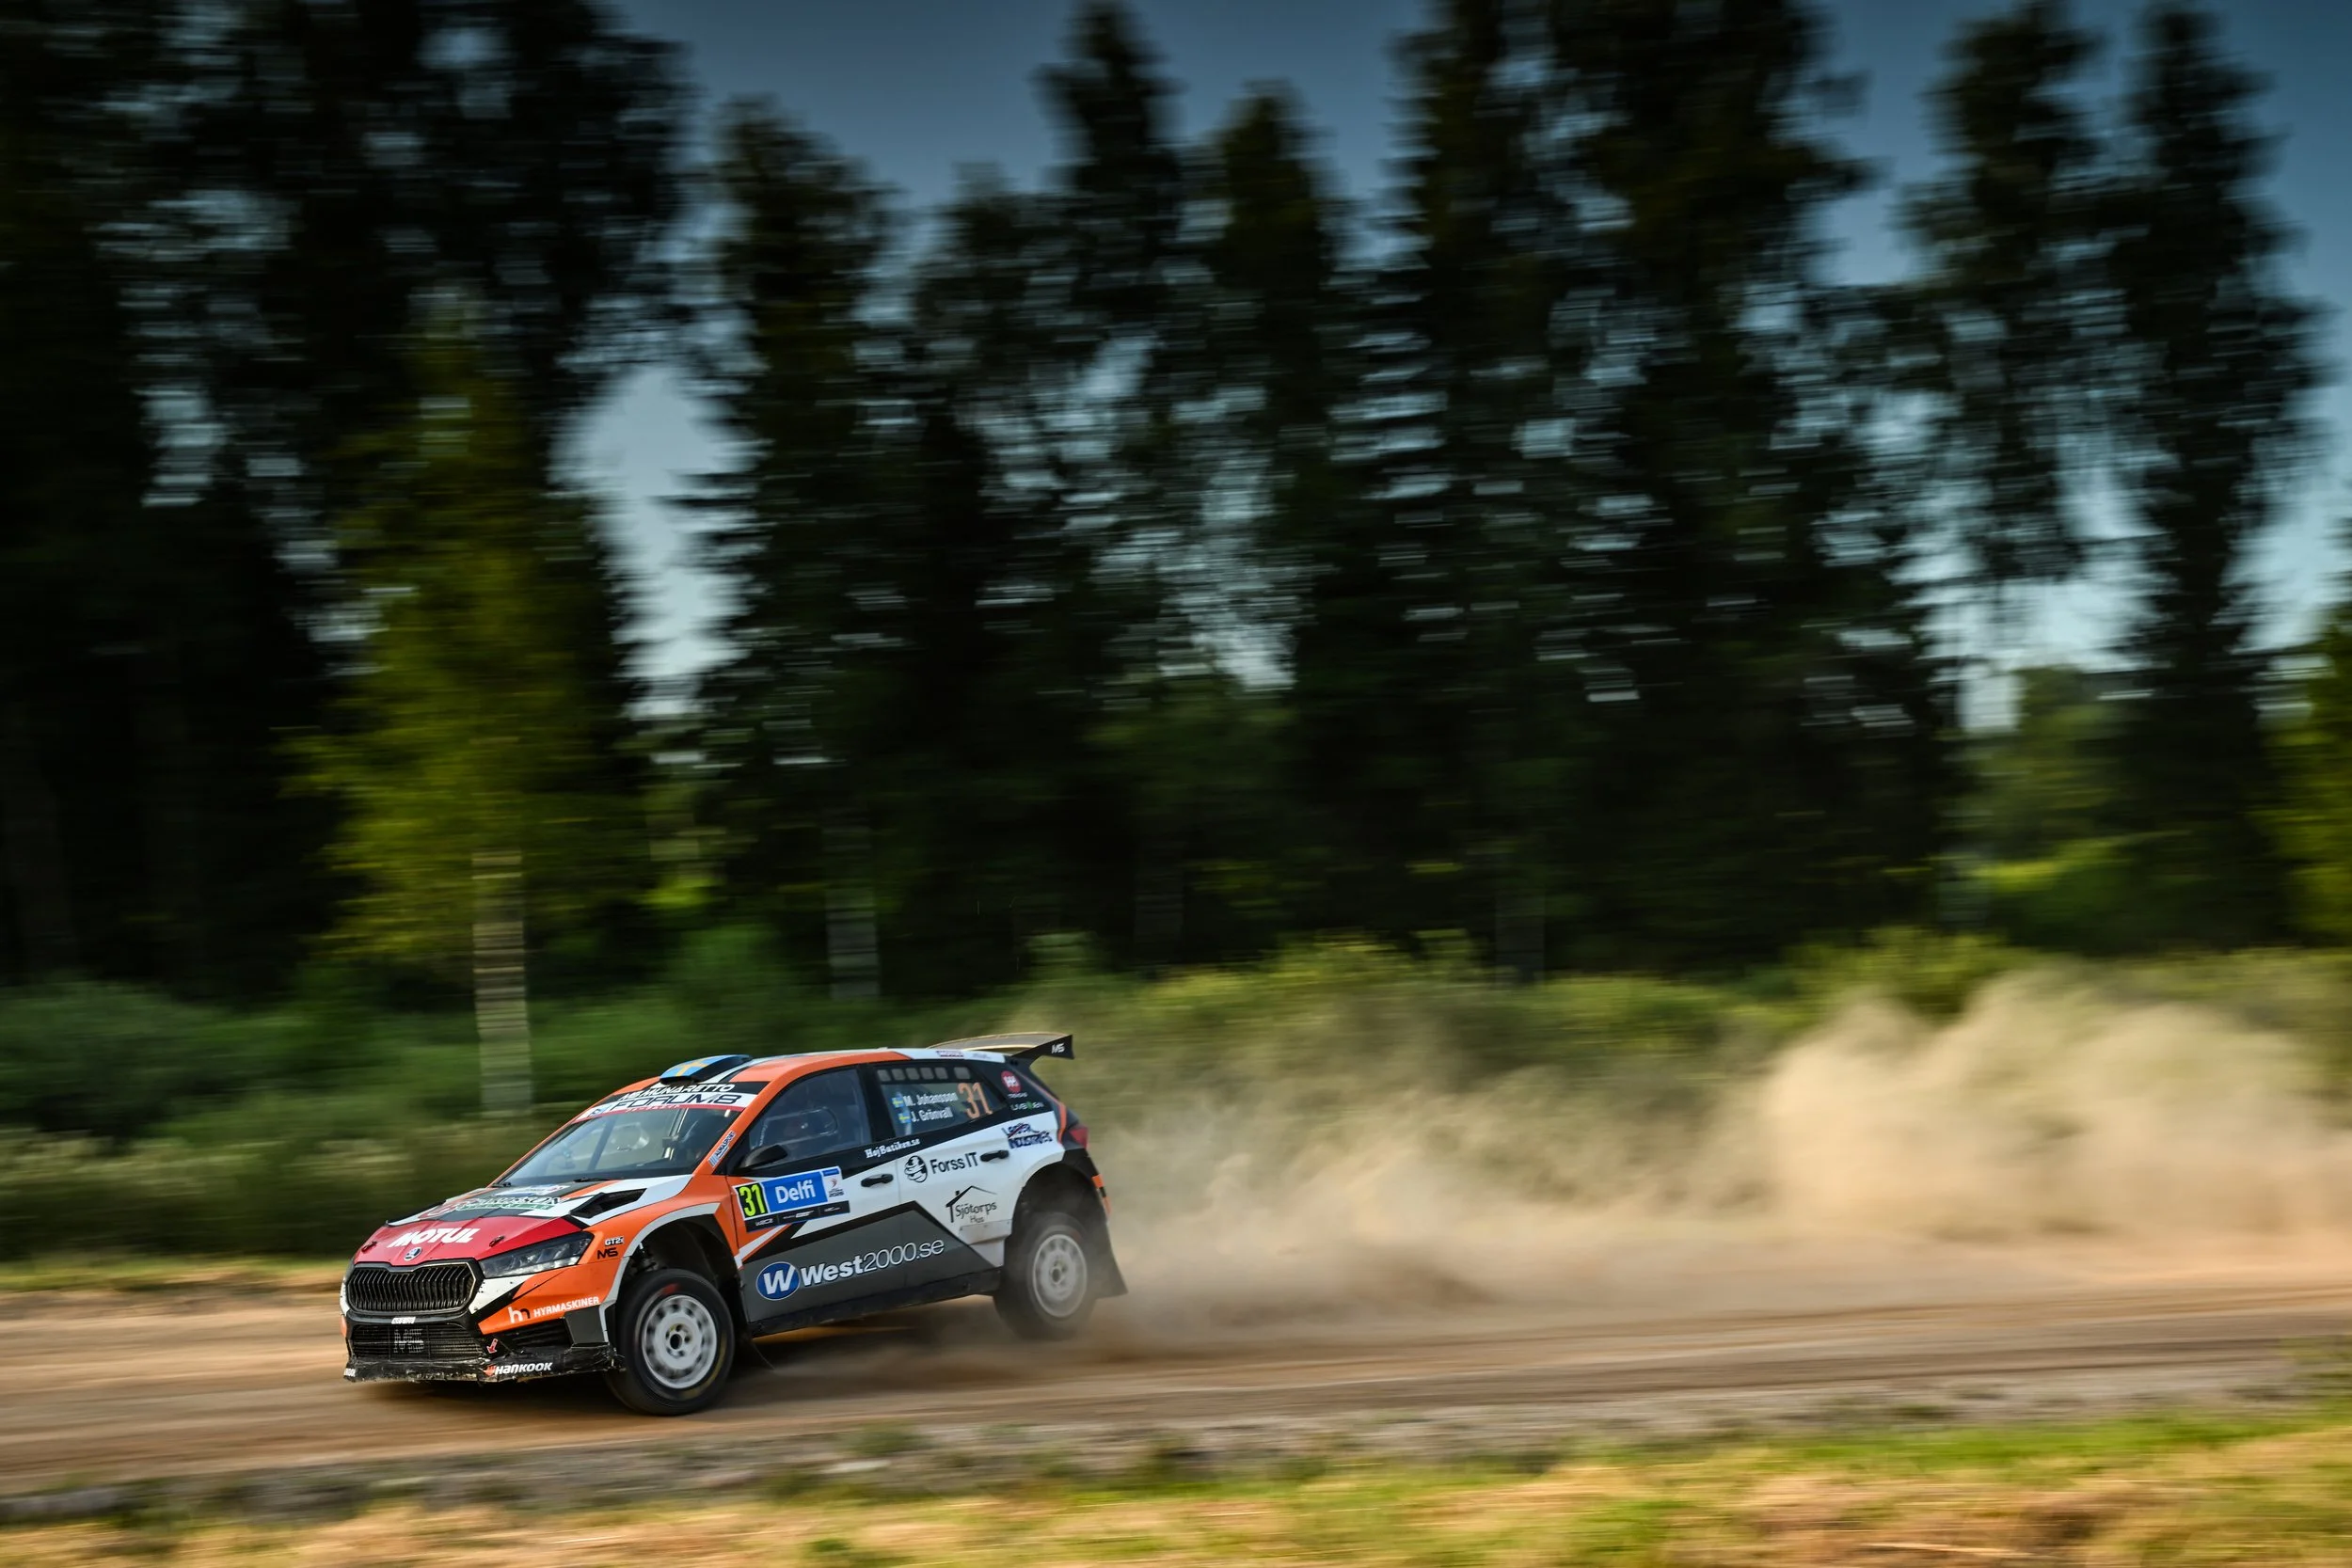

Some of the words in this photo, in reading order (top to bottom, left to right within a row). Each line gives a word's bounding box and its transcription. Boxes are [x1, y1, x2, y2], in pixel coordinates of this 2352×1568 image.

[612, 1093, 742, 1109] FORUM8
[641, 1084, 734, 1098] MUNARETTO
[902, 1095, 916, 1107] M.
[915, 1091, 959, 1106] Johansson
[958, 1082, 993, 1119] 31
[910, 1111, 919, 1123] J.
[918, 1106, 954, 1122] Grönvall
[930, 1157, 965, 1174] Forss
[964, 1151, 978, 1168] IT
[739, 1183, 766, 1217] 31
[774, 1179, 817, 1204] Delfi
[955, 1201, 997, 1219] Sjötorps
[387, 1227, 481, 1248] MOTUL
[763, 1263, 797, 1295] W
[801, 1239, 946, 1287] West2000.se
[532, 1296, 600, 1319] HYRMASKINER
